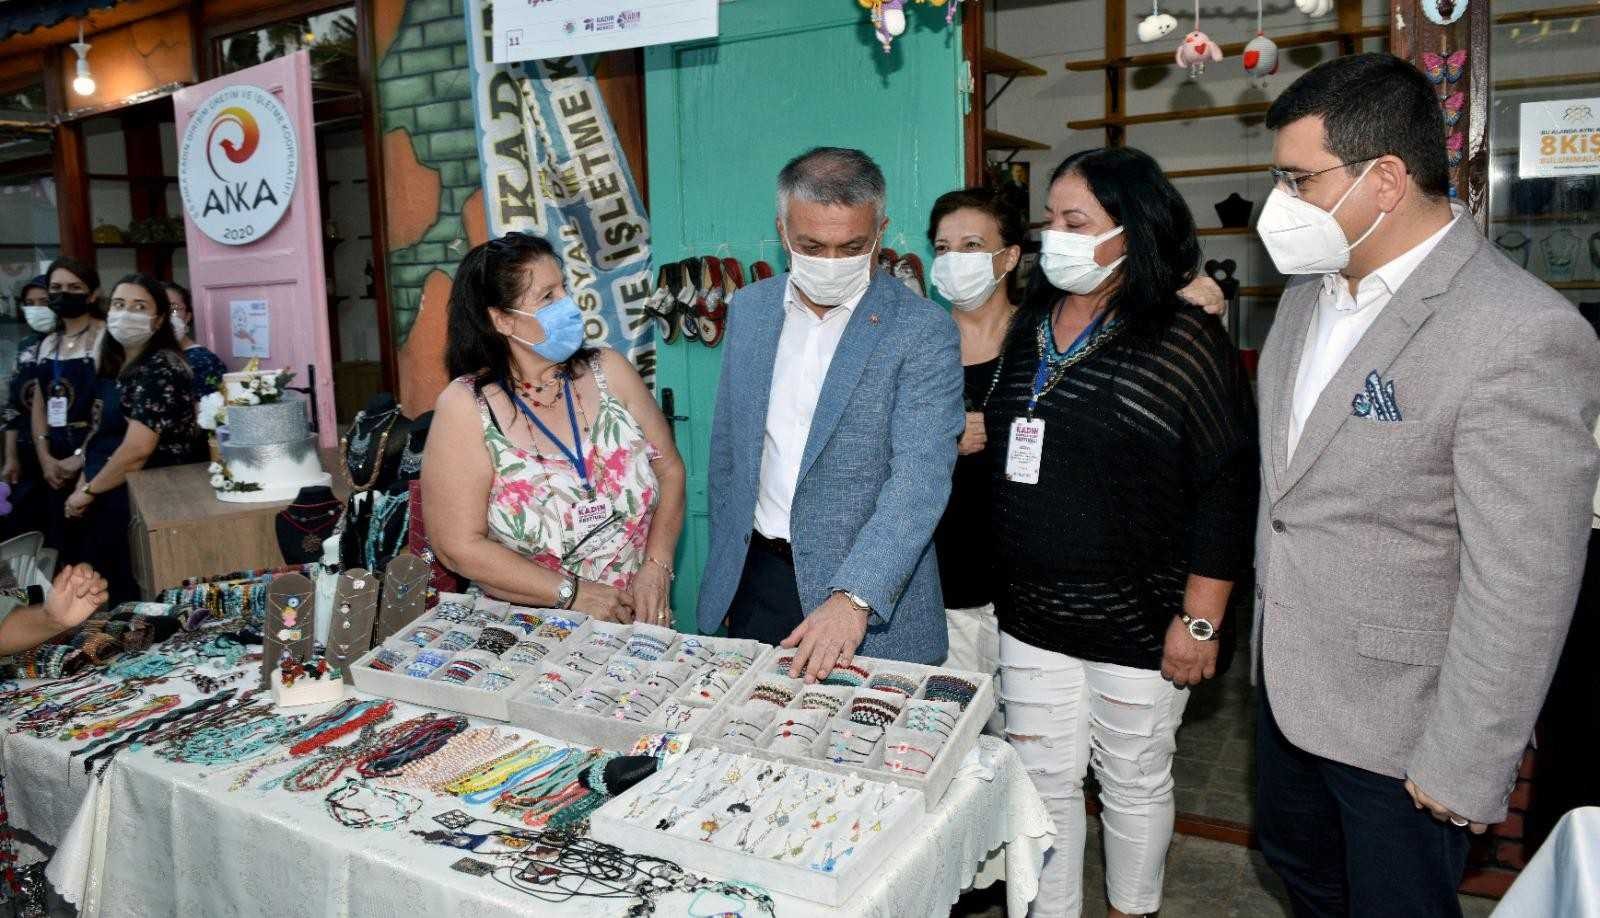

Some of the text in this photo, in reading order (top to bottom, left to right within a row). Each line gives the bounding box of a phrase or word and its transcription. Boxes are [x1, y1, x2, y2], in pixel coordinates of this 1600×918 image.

[509, 36, 520, 47] 11
[559, 89, 644, 264] İŞLETME
[202, 178, 279, 219] ANKA
[223, 224, 255, 240] 2020
[562, 218, 605, 340] OSYAL
[620, 278, 652, 332] VE
[578, 503, 606, 516] KADIN
